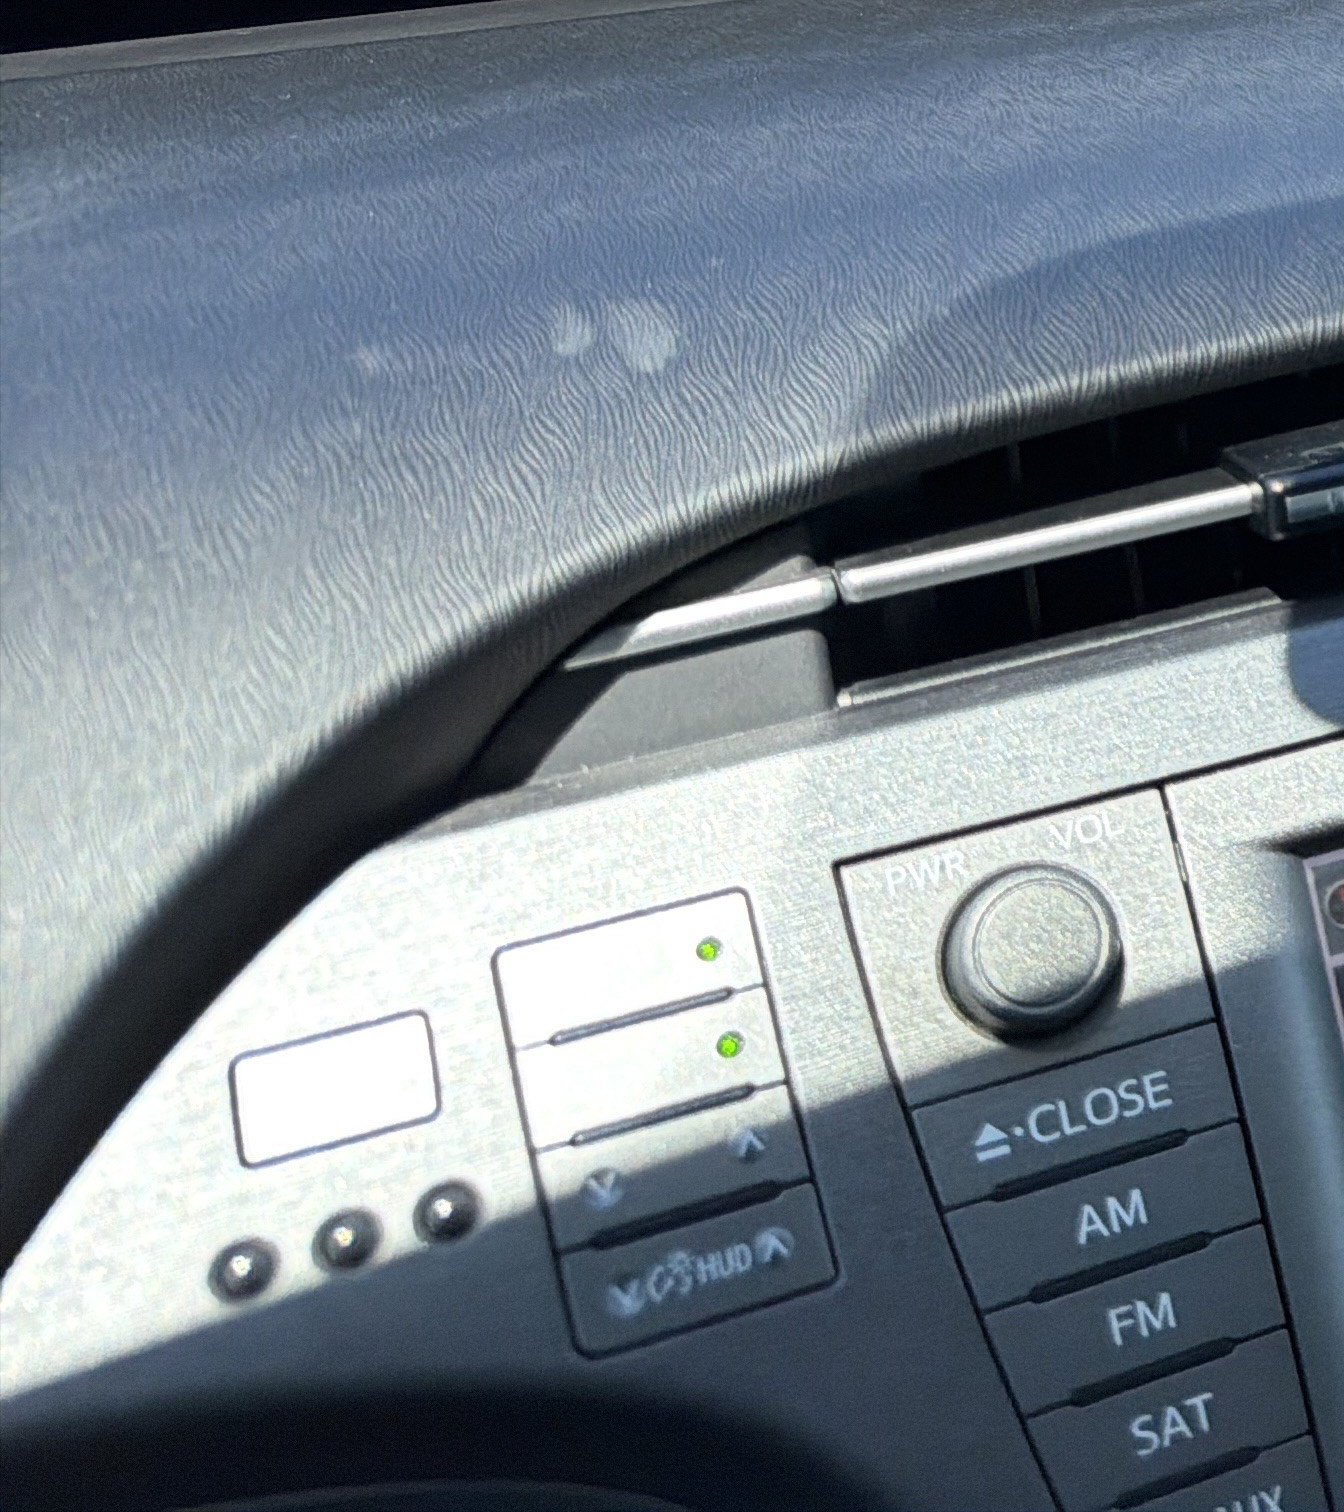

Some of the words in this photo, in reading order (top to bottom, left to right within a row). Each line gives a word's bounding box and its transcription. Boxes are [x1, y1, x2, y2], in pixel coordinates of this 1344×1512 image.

[1050, 813, 1125, 850] VOL
[885, 850, 968, 897] PWR
[1024, 1070, 1173, 1145] CLOSE
[1076, 1189, 1149, 1245] AM
[696, 1243, 753, 1284] HUD
[1107, 1291, 1178, 1346] FM
[1129, 1392, 1214, 1457] SAT
